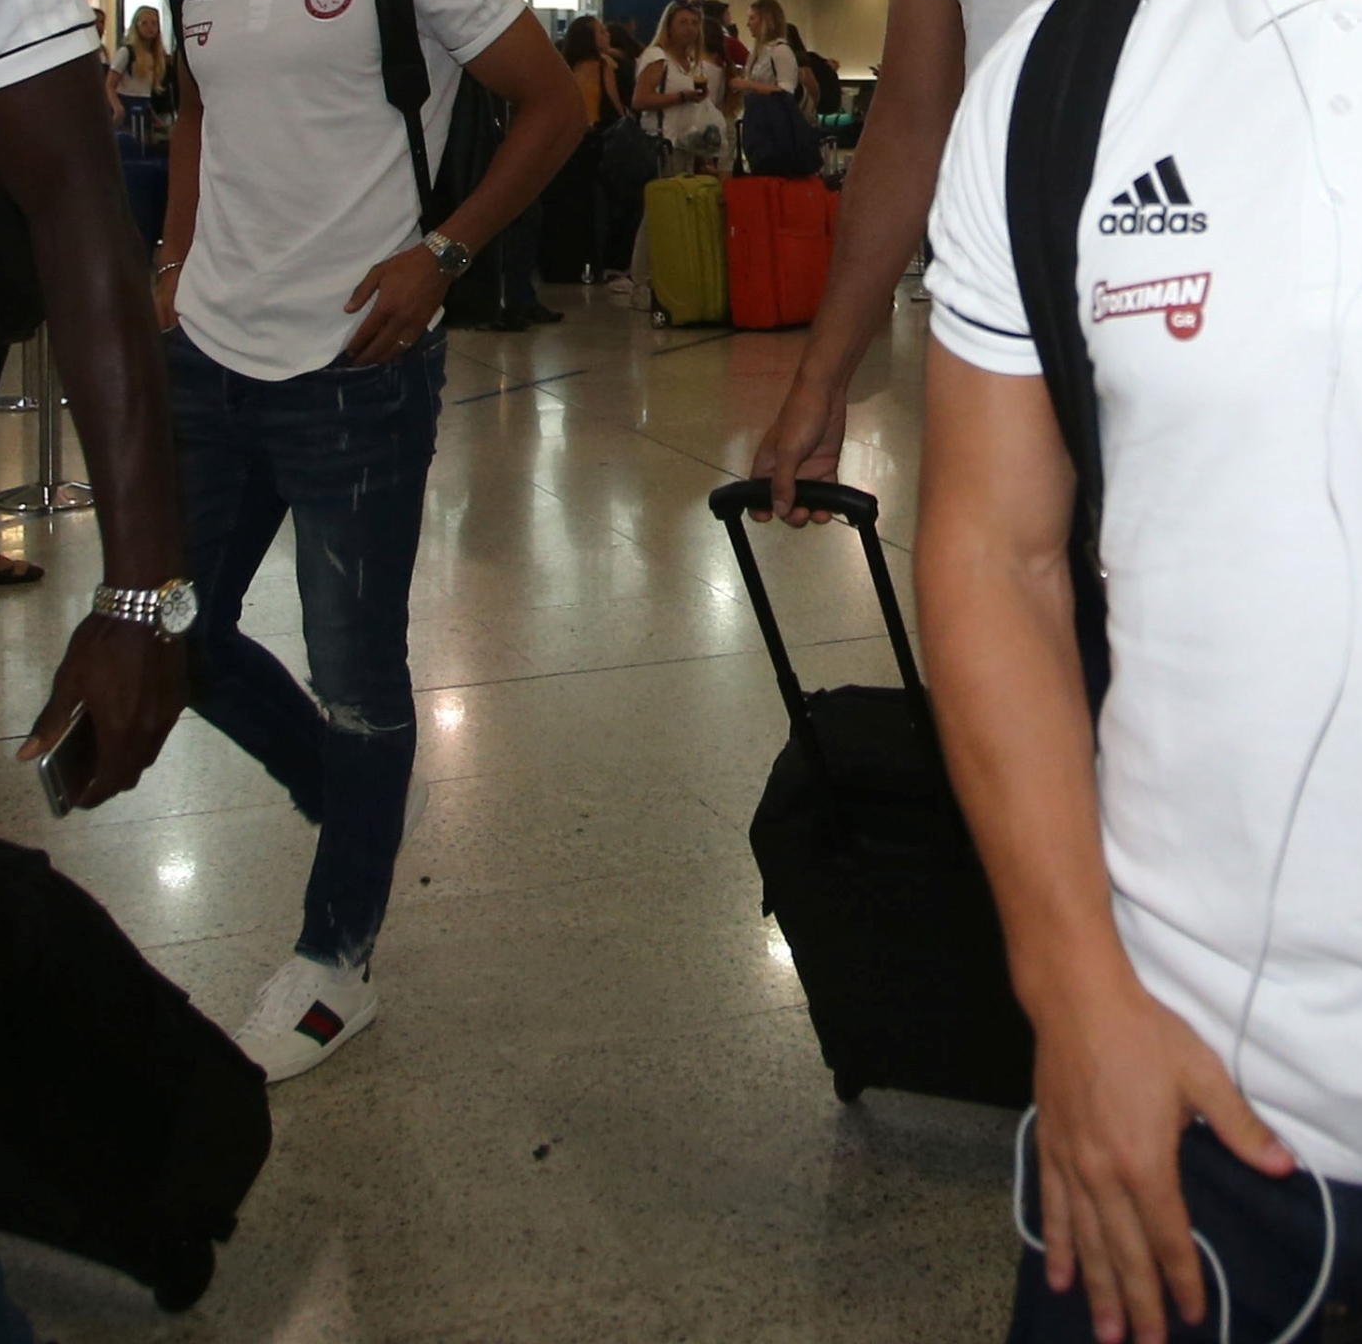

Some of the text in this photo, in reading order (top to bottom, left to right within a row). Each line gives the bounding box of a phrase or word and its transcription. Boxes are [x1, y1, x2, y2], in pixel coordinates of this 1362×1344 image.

[1099, 204, 1209, 236] adidas
[1094, 275, 1209, 329] STOIXIMAN GR
